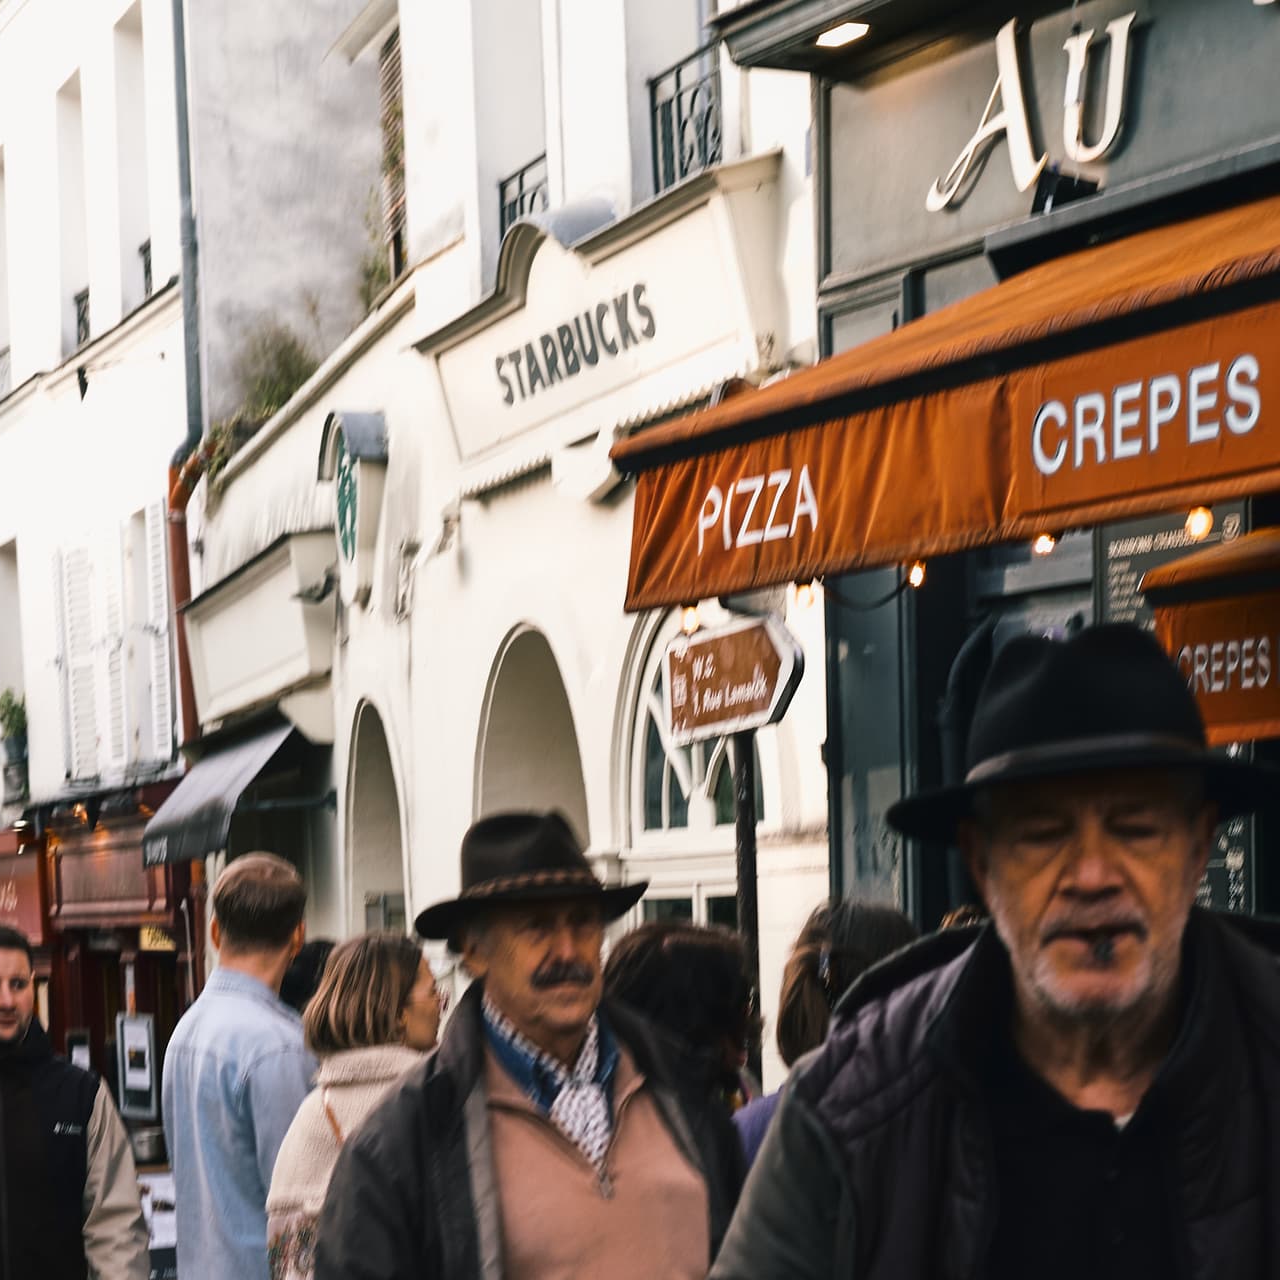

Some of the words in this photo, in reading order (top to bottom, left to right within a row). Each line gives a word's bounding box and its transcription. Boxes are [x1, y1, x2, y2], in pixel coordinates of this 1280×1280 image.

[495, 283, 656, 406] STARBUCKS
[1031, 353, 1262, 476] CREPES
[697, 463, 819, 557] PIZZA
